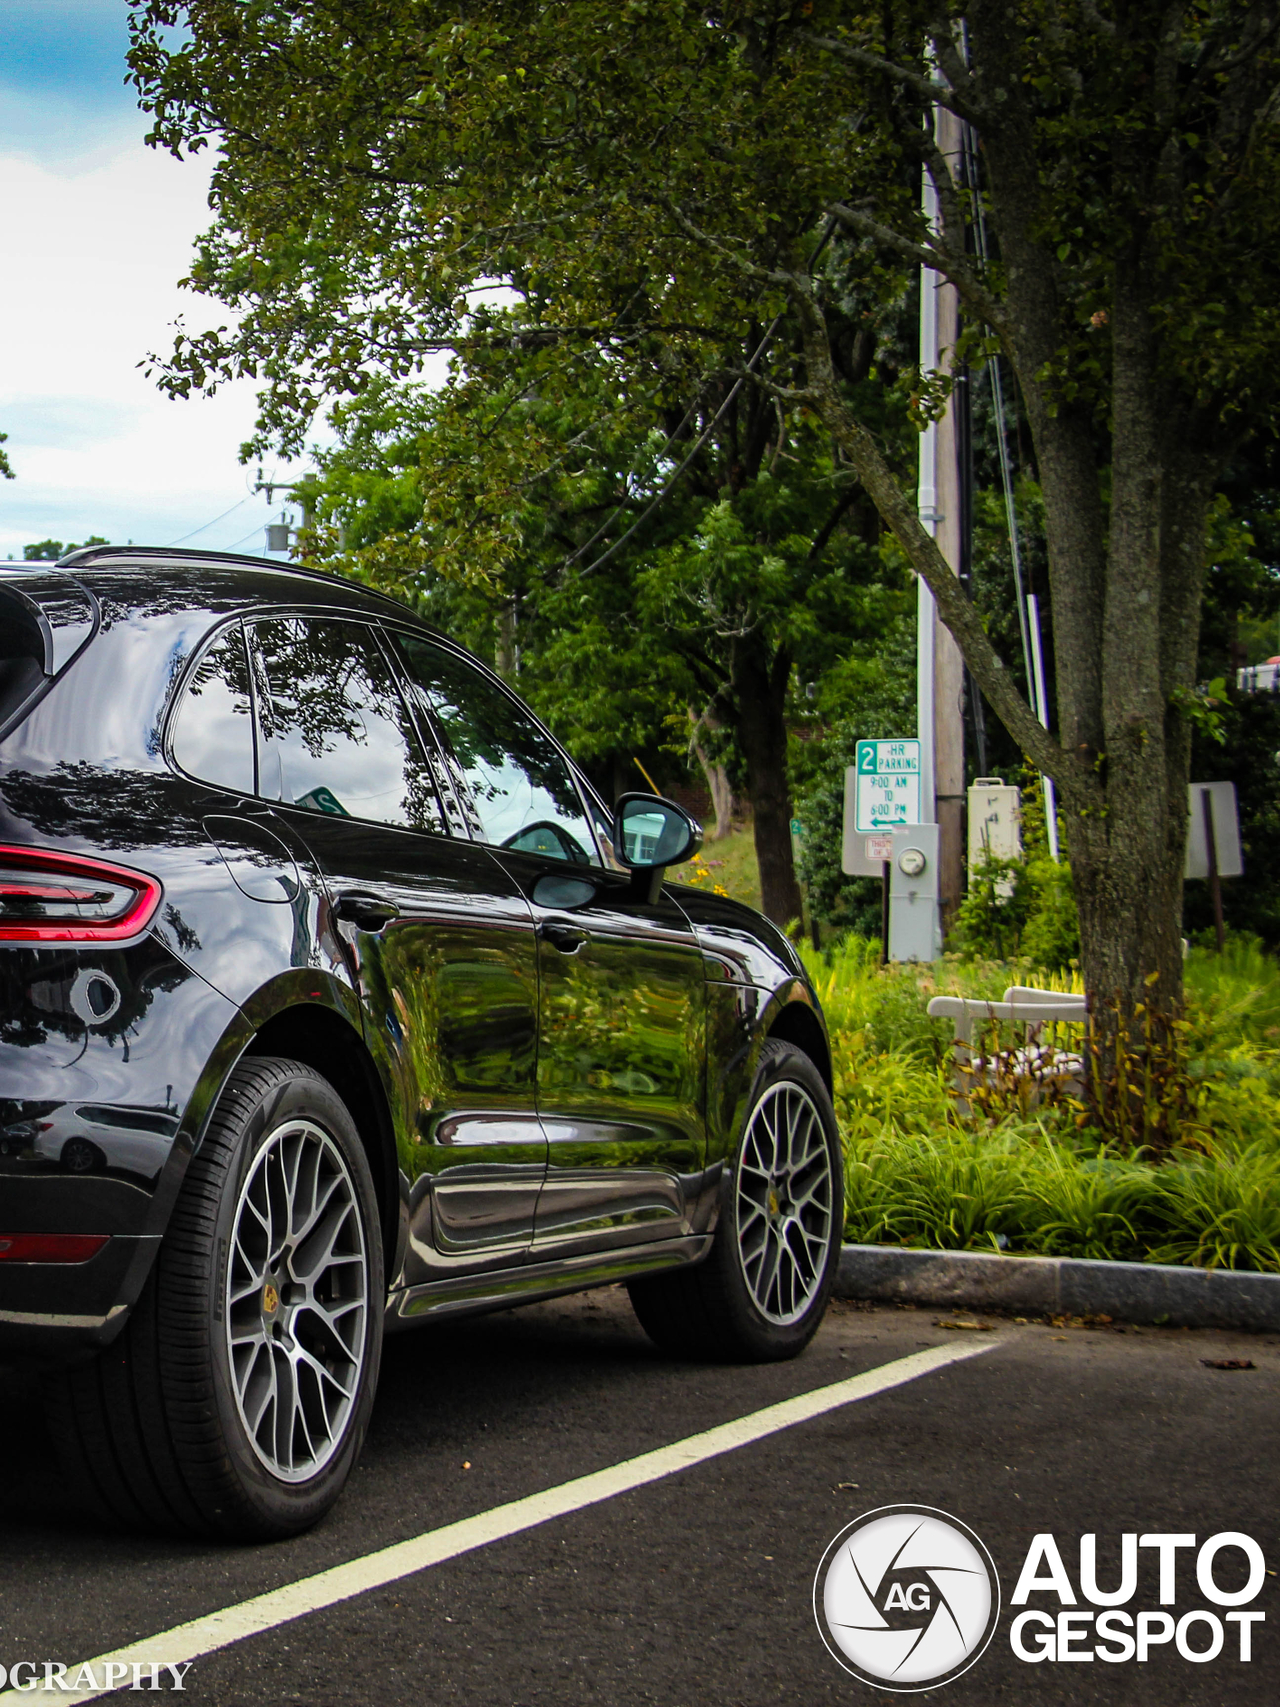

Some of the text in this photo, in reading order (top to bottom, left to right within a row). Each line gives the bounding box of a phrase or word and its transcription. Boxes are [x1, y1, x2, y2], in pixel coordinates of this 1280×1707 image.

[862, 747, 874, 769] 2
[878, 758, 917, 769] PARKING
[870, 776, 908, 788] 9:00 AM
[884, 790, 894, 802] TO
[871, 804, 907, 815] 6:00 PM
